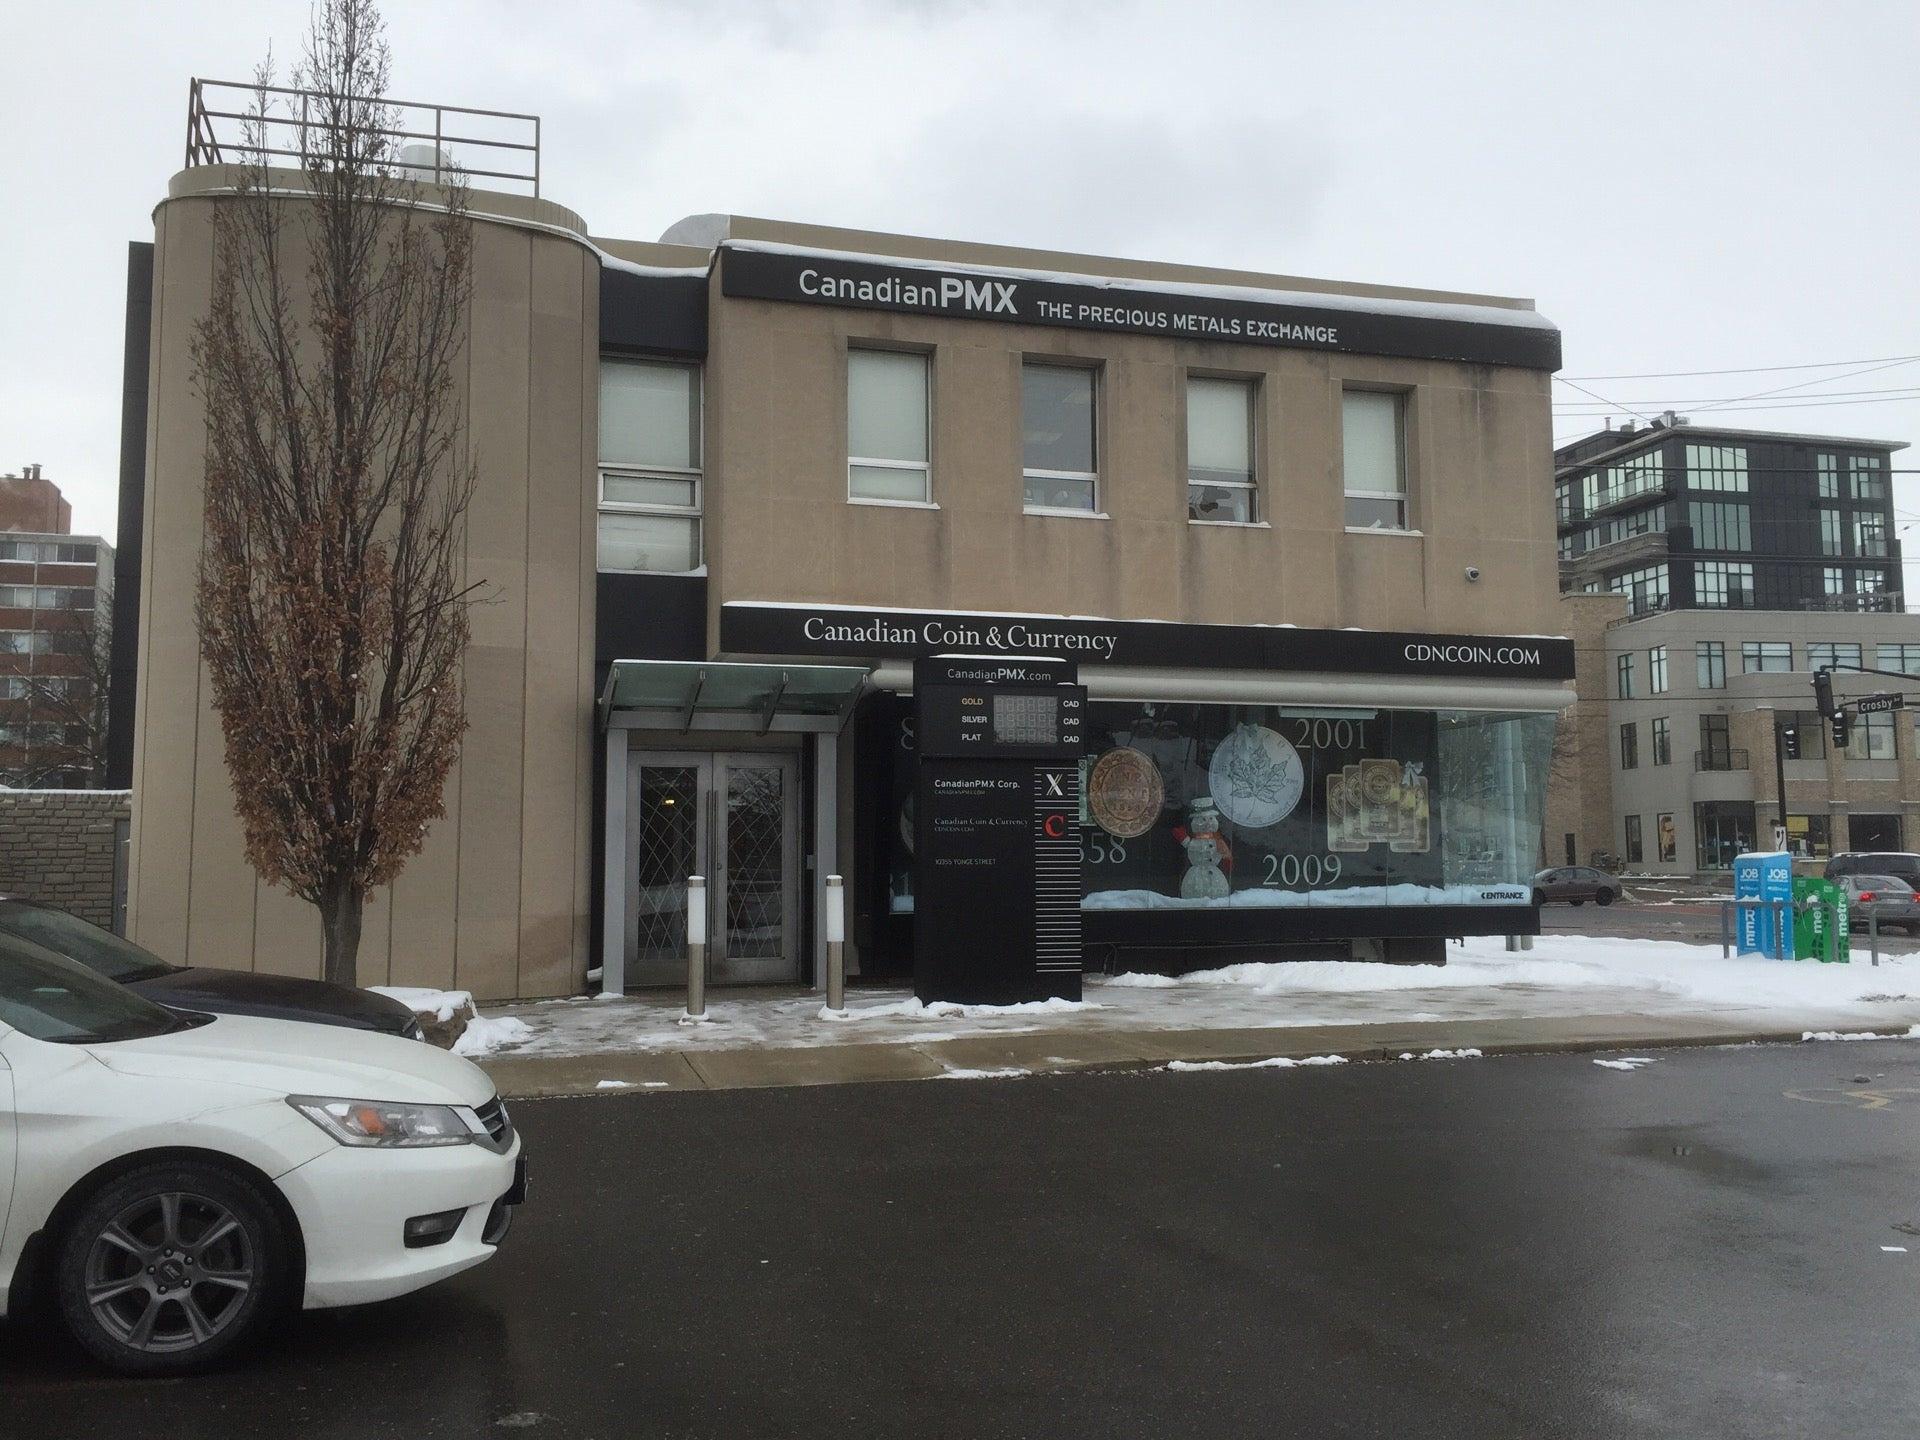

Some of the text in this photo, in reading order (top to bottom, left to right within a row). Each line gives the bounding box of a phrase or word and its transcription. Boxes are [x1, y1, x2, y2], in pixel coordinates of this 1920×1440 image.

[799, 269, 1338, 344] CanadianPMX THE PRECIOUS METALS EXCHANGE
[804, 617, 918, 644] Canadian
[923, 622, 981, 646] Coin
[1404, 644, 1540, 665] CDNCOIN.COM
[947, 668, 1051, 681] CanadianPMX.com
[961, 698, 1080, 708] GOLD CAD
[1860, 698, 1893, 712] Crosby
[961, 716, 1080, 726] SILVER CAD
[961, 733, 1080, 743] PLAT CAD
[1295, 718, 1367, 750] 2001
[934, 779, 1021, 789] CanadianPMX Corp.
[934, 817, 968, 825] Canadian
[1045, 815, 1064, 838] C
[1079, 832, 1127, 864] 58
[1262, 854, 1342, 886] 2009
[1740, 868, 1759, 879] JOB
[1768, 868, 1789, 879] JOB
[1485, 891, 1524, 900] ENTRANCE
